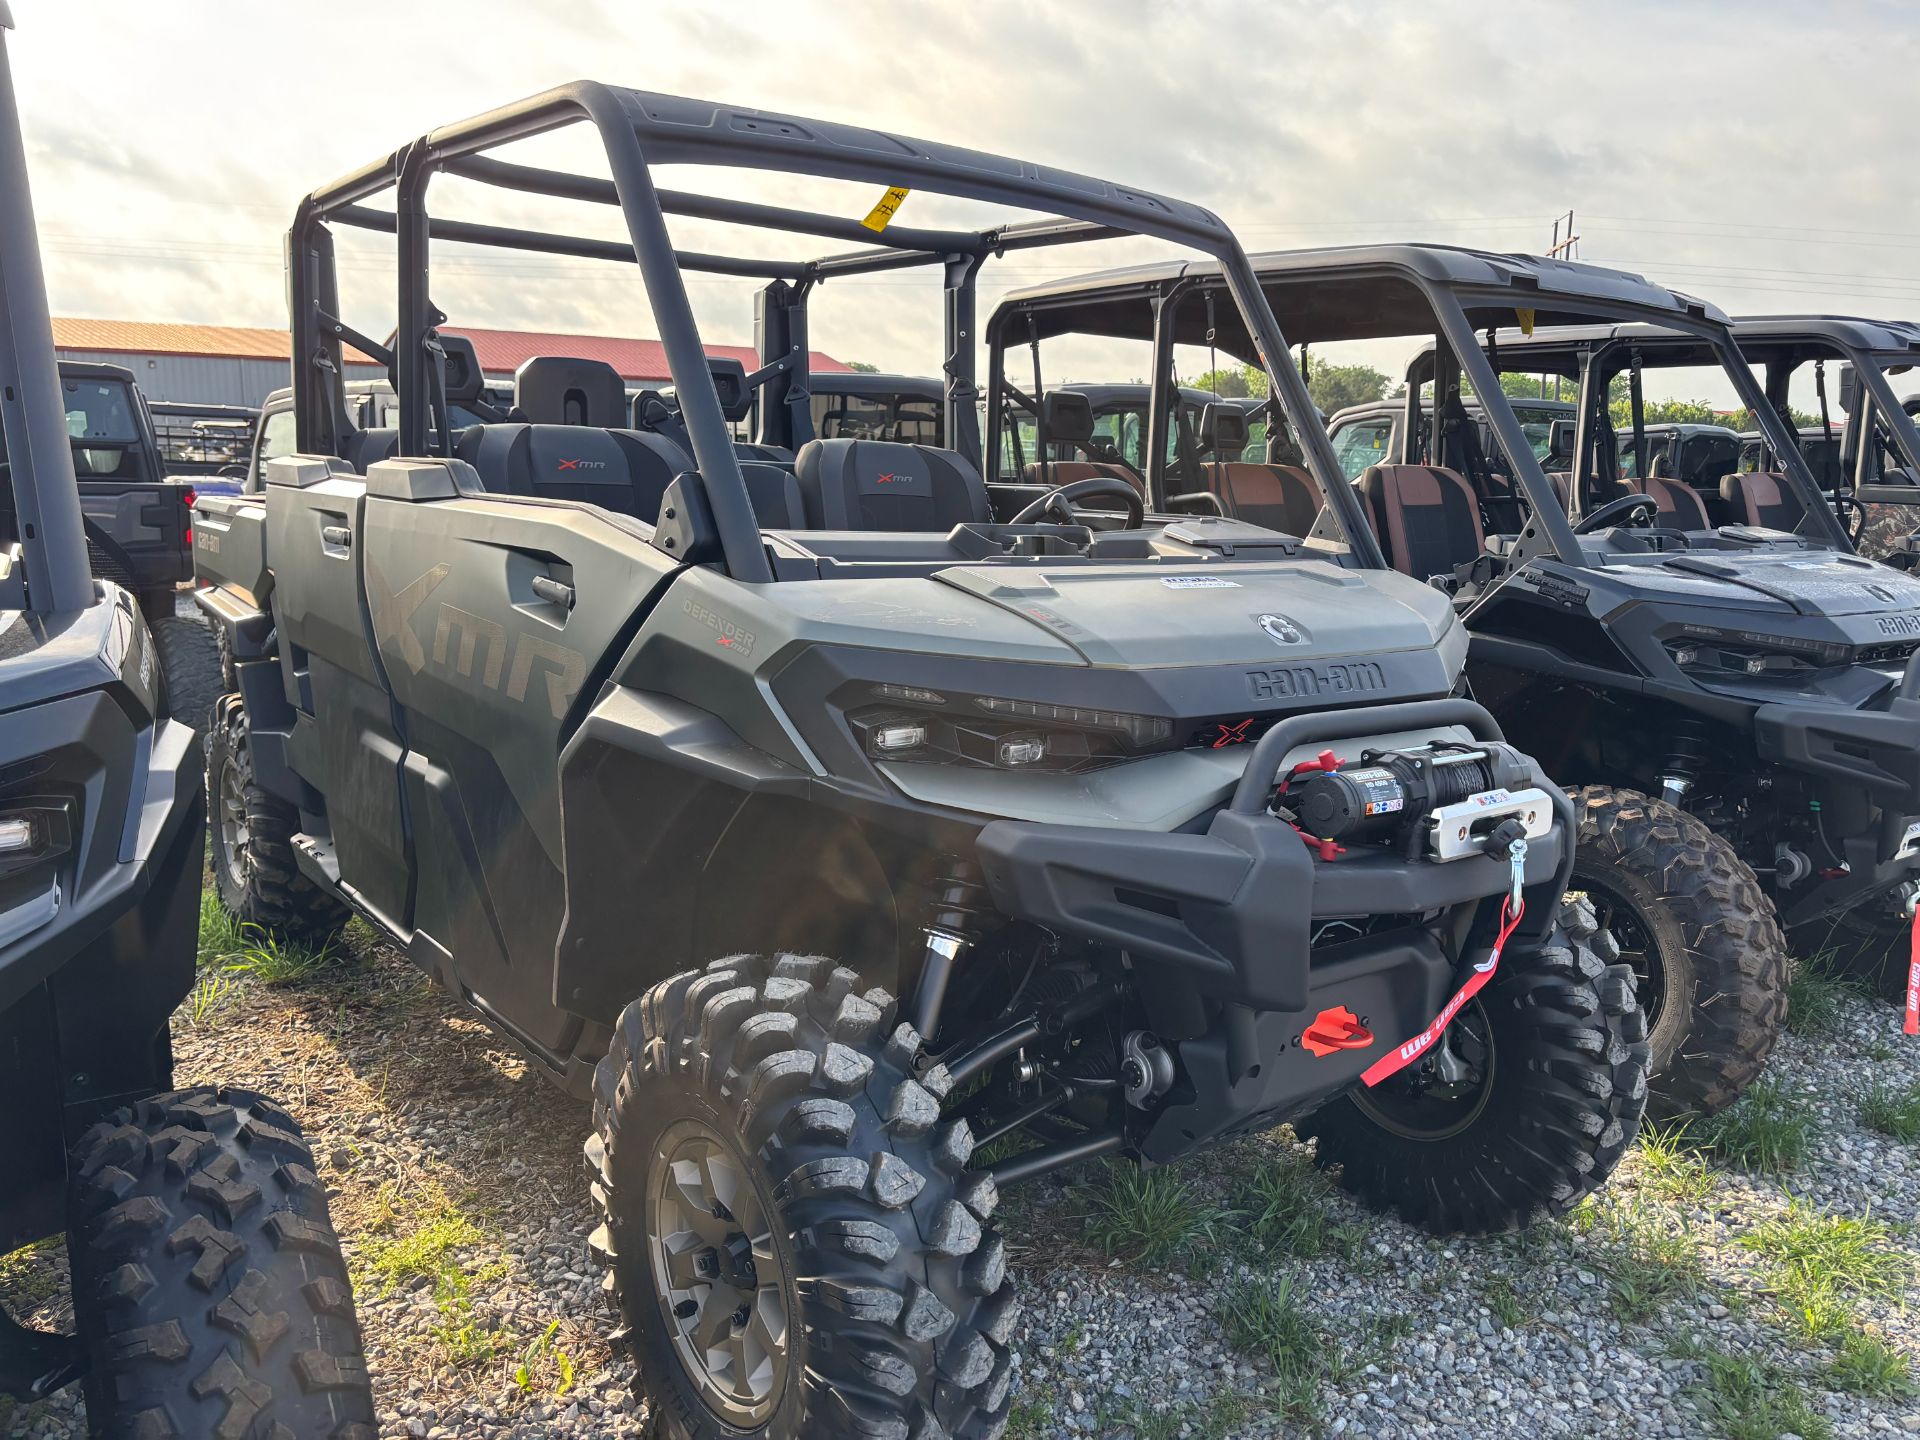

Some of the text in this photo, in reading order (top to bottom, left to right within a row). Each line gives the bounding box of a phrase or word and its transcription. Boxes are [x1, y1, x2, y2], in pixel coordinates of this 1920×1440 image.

[682, 599, 754, 648] DEFENDER
[1874, 615, 1920, 636] can-a
[1245, 662, 1387, 700] can-am
[1400, 991, 1465, 1060] can-am
